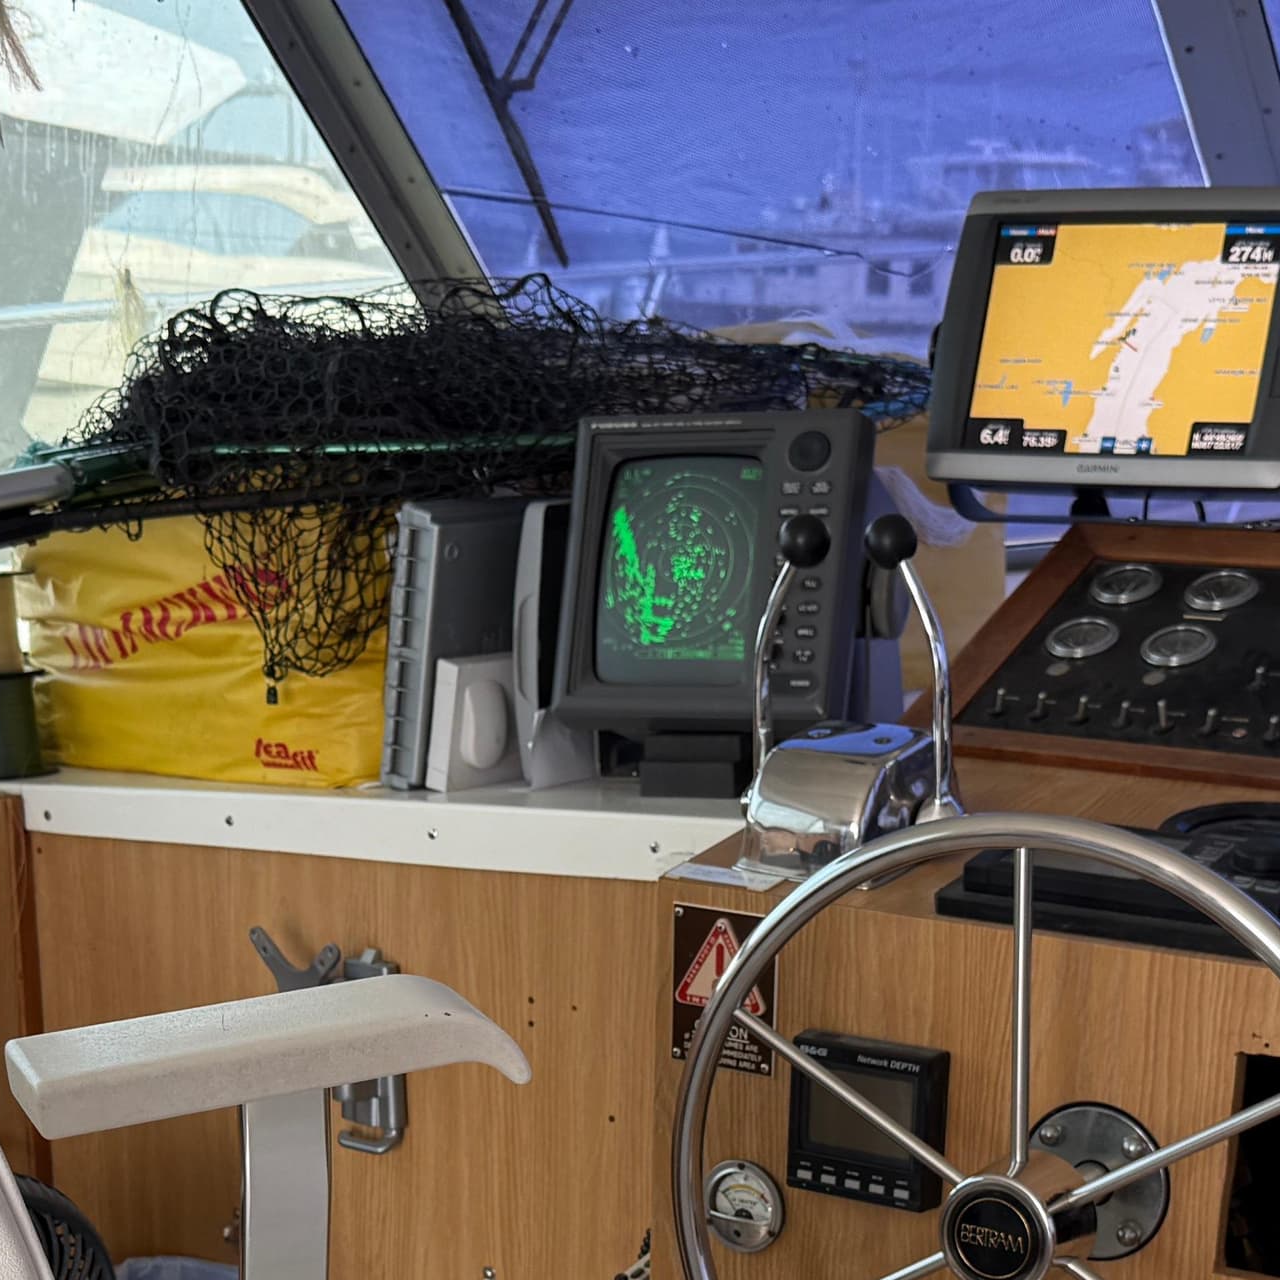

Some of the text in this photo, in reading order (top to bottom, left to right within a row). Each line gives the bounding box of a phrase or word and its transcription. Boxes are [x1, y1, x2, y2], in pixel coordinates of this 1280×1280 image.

[1076, 463, 1120, 475] GARMIN
[722, 1049, 763, 1063] MMEDIATELY
[857, 1054, 920, 1073] Network DEPTH
[961, 1223, 1024, 1254] BERTRAM
